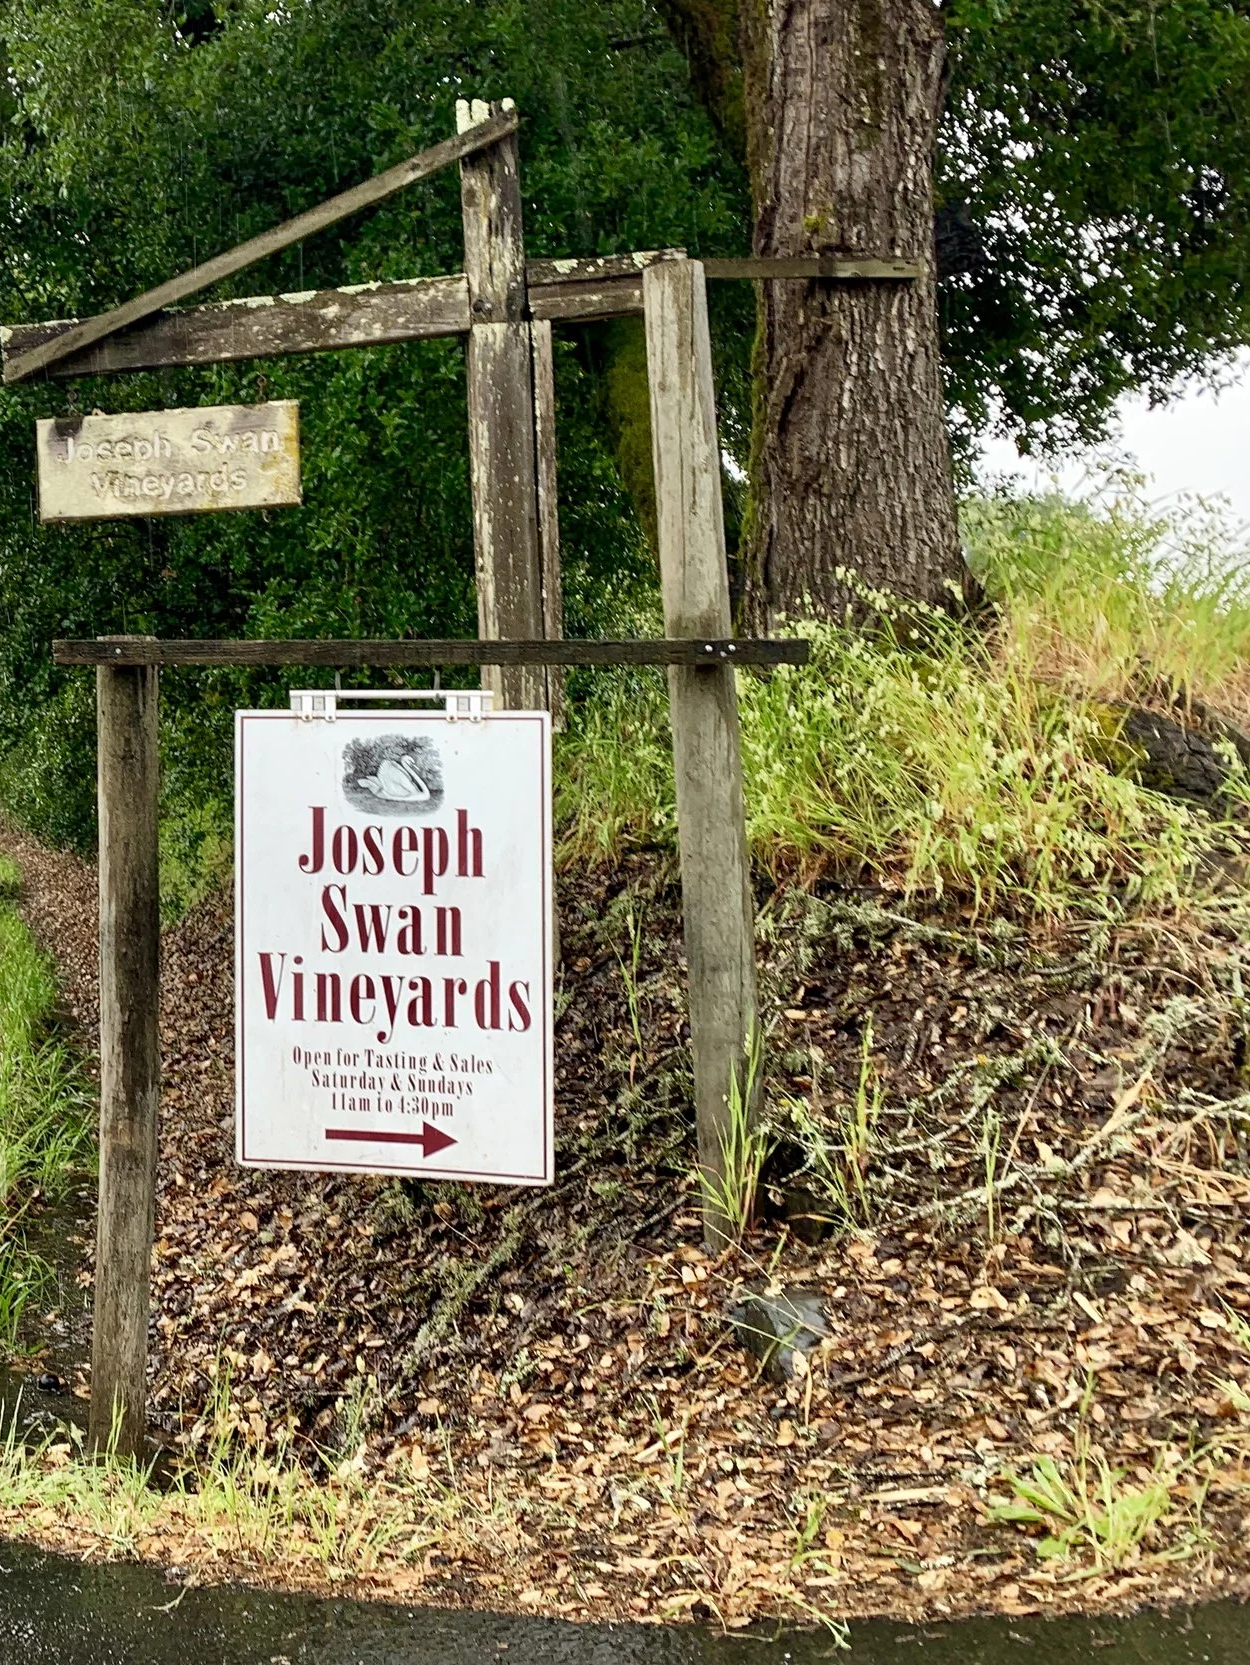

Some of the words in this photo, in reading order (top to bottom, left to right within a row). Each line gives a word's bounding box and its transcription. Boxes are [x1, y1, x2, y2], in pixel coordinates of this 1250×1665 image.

[56, 428, 172, 465] Joseph
[190, 426, 280, 456] Swan
[90, 461, 248, 501] Vineyards
[298, 805, 487, 896] Joseph
[320, 882, 463, 958] Swan
[258, 951, 532, 1045] Vineyards
[292, 1045, 332, 1070] Open
[337, 1048, 360, 1068] for
[365, 1048, 428, 1074] Tasting
[432, 1052, 445, 1072] &
[449, 1052, 494, 1074] Sales
[311, 1068, 385, 1092] Saturday
[390, 1072, 402, 1092] &
[407, 1073, 474, 1100] Sundays
[331, 1091, 372, 1112] 11am
[377, 1093, 393, 1114] to
[397, 1095, 455, 1121] 4:30pm
